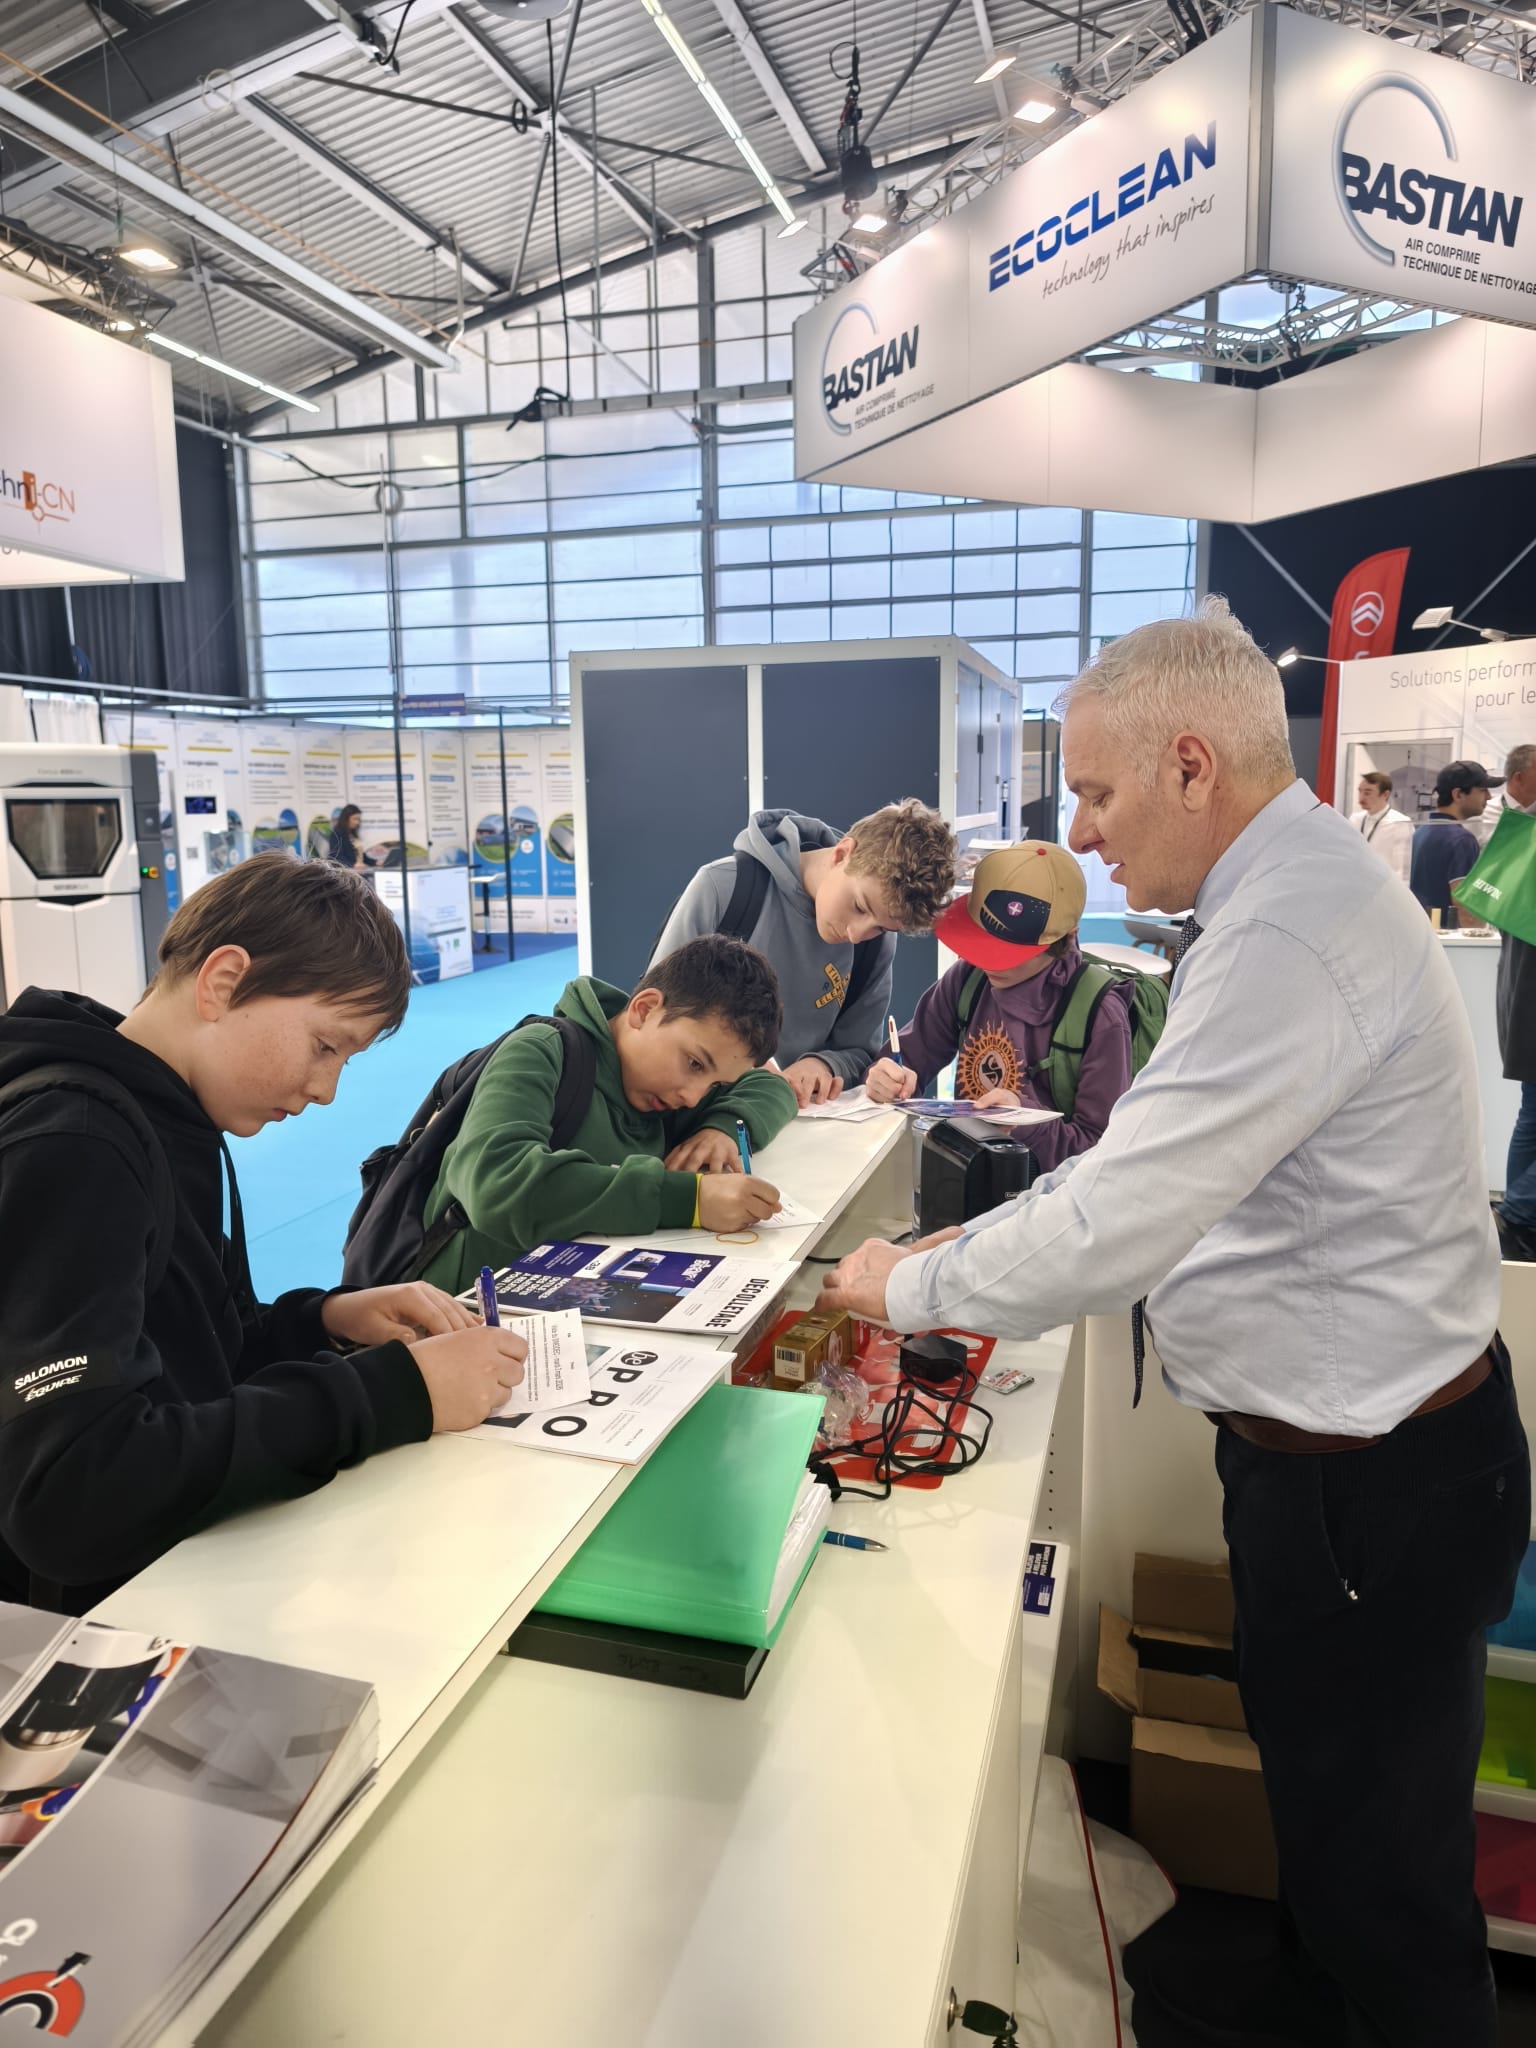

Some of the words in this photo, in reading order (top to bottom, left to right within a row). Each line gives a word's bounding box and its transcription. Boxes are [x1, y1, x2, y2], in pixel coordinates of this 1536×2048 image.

[988, 119, 1217, 293] ECOCLEAN
[1341, 151, 1524, 248] BASTIAN
[1042, 253, 1111, 299] technology
[1116, 225, 1151, 260] that
[1155, 194, 1215, 241] inspires
[1404, 237, 1424, 253] AIR
[1425, 242, 1482, 265] COMPRIME
[1402, 255, 1463, 279] TECHNIQUE
[1463, 268, 1478, 282] DE
[1480, 271, 1536, 295] NETTOYAGE
[822, 324, 919, 412] BASTIAN
[1390, 666, 1463, 689] Solutions
[1474, 691, 1516, 713] pour
[704, 1278, 771, 1328] DÉCOLLETAGE
[14, 1355, 88, 1391] SALOMON
